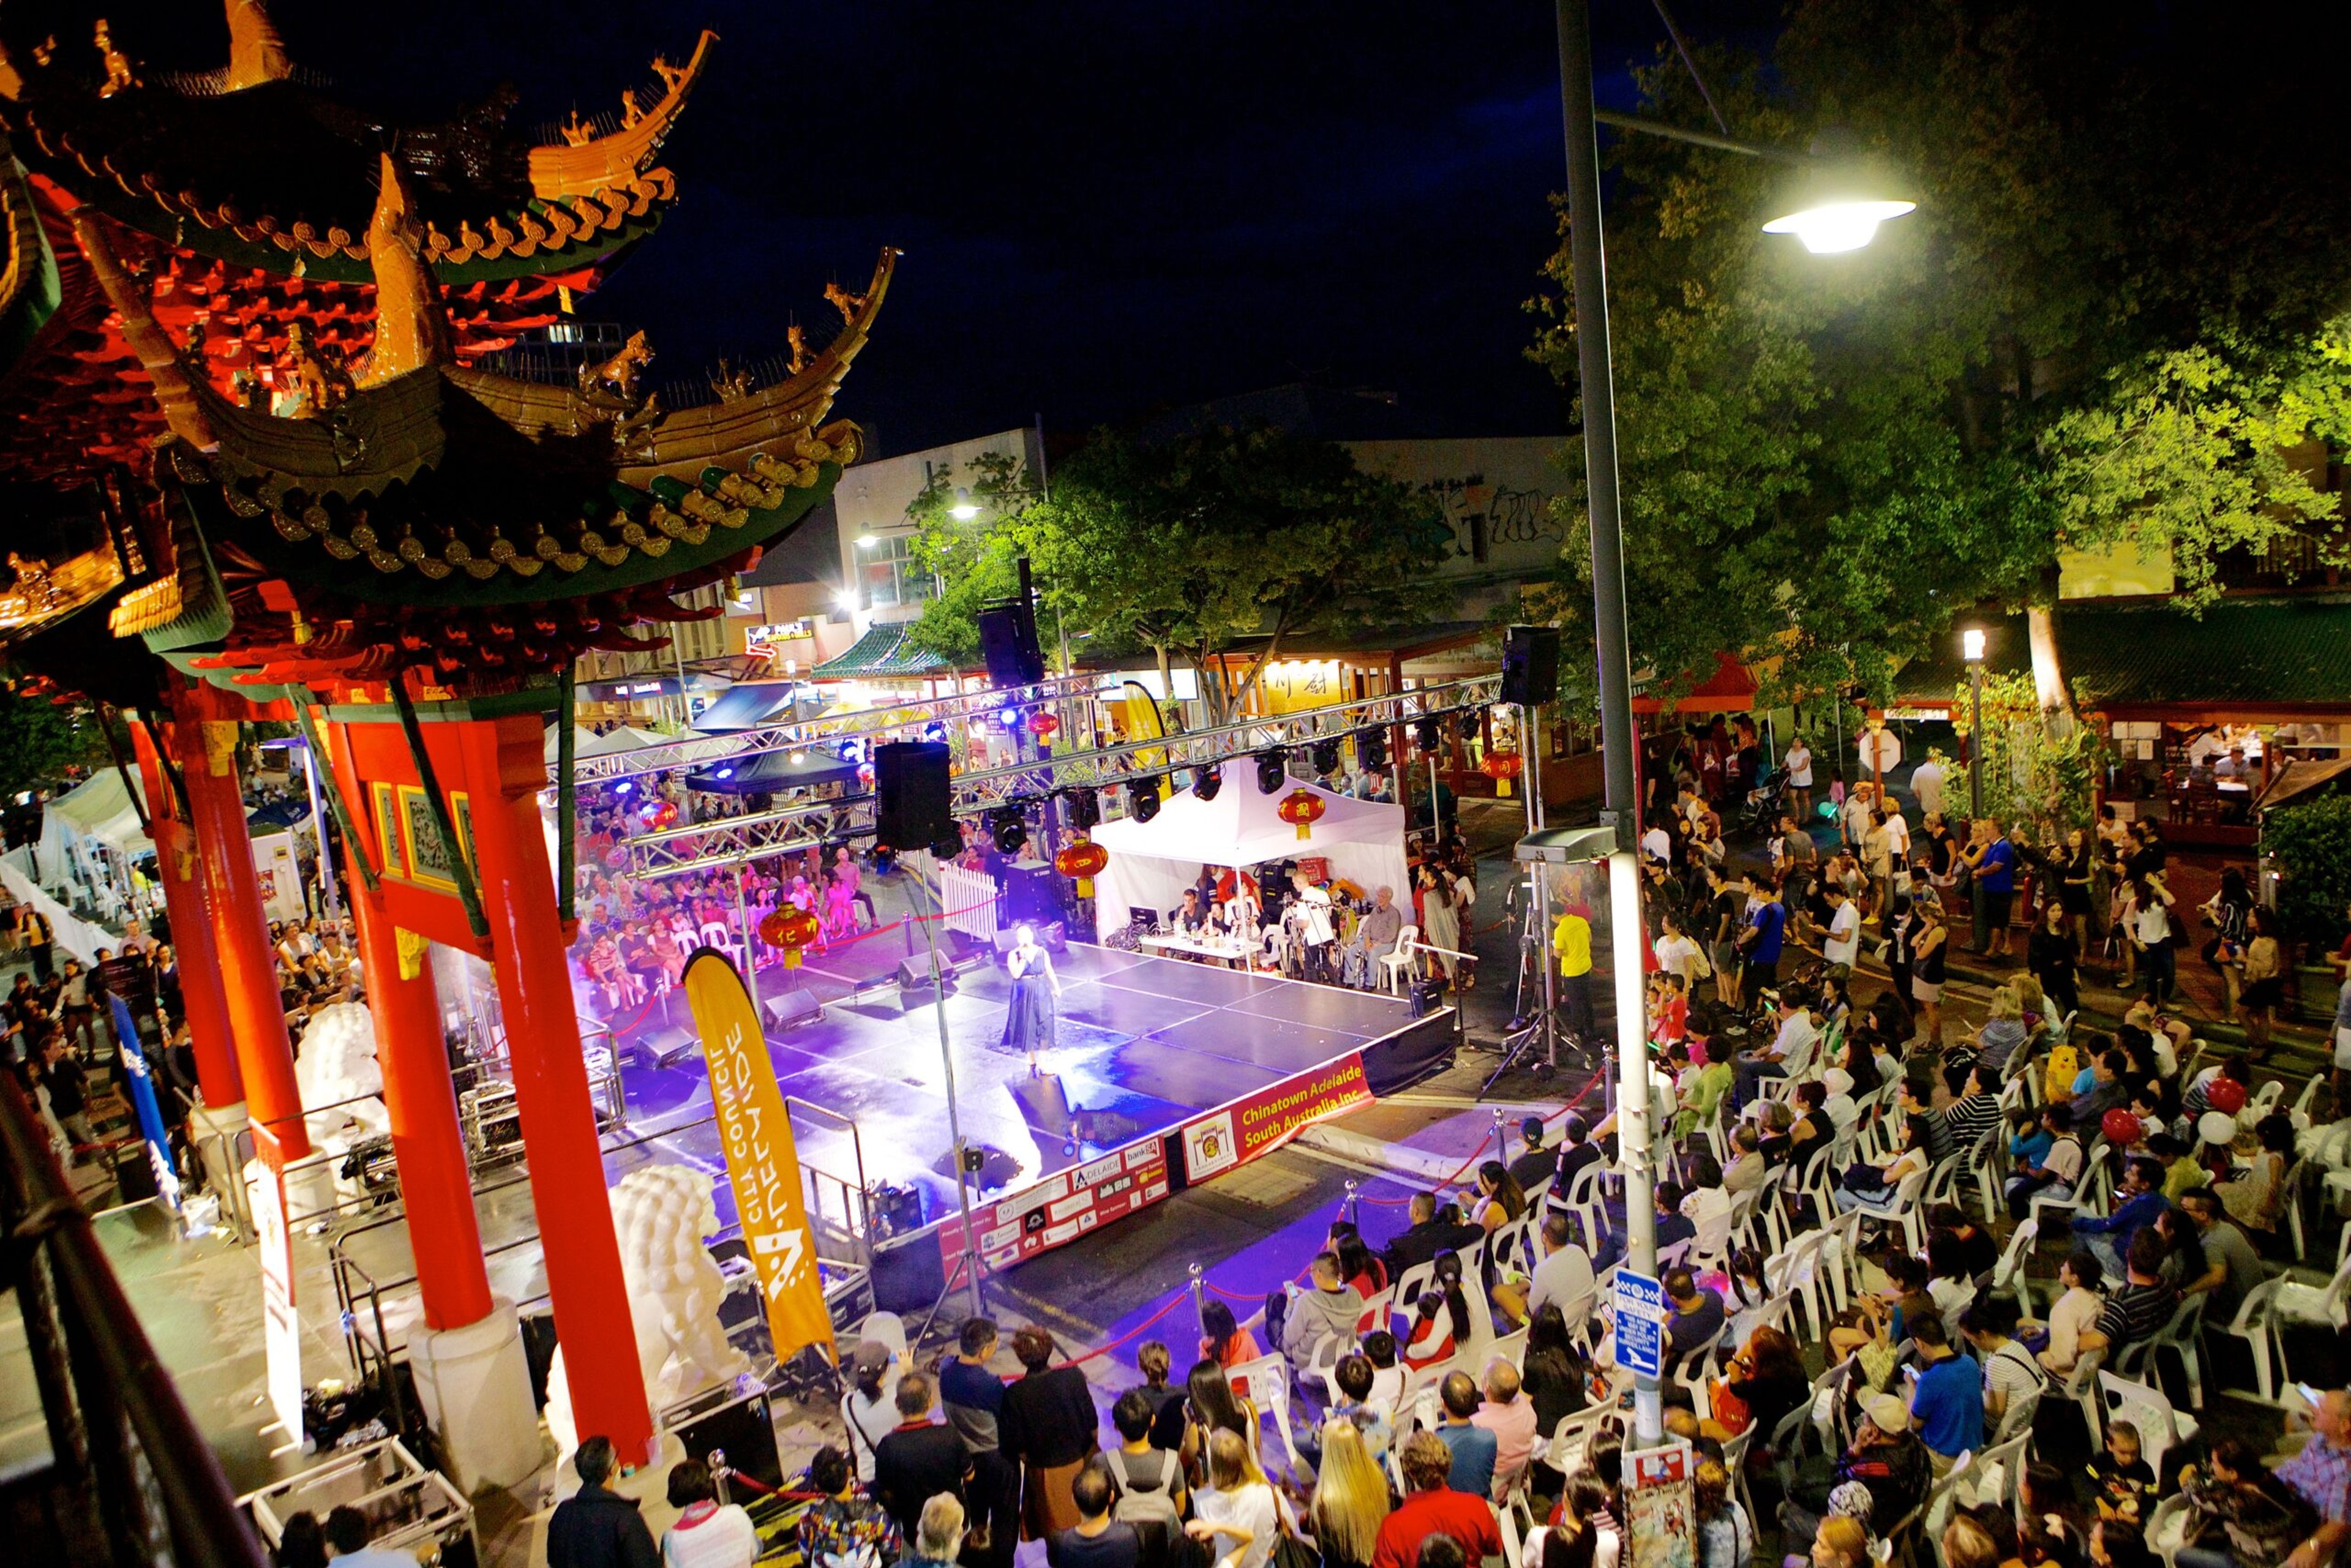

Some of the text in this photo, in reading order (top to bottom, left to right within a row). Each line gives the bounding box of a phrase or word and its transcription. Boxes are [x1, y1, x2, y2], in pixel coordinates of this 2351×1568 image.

[1242, 1065, 1362, 1125] Chinatown Adelaide
[1245, 1088, 1364, 1149] South Australia Inc.
[1127, 1141, 1158, 1161] bankSA
